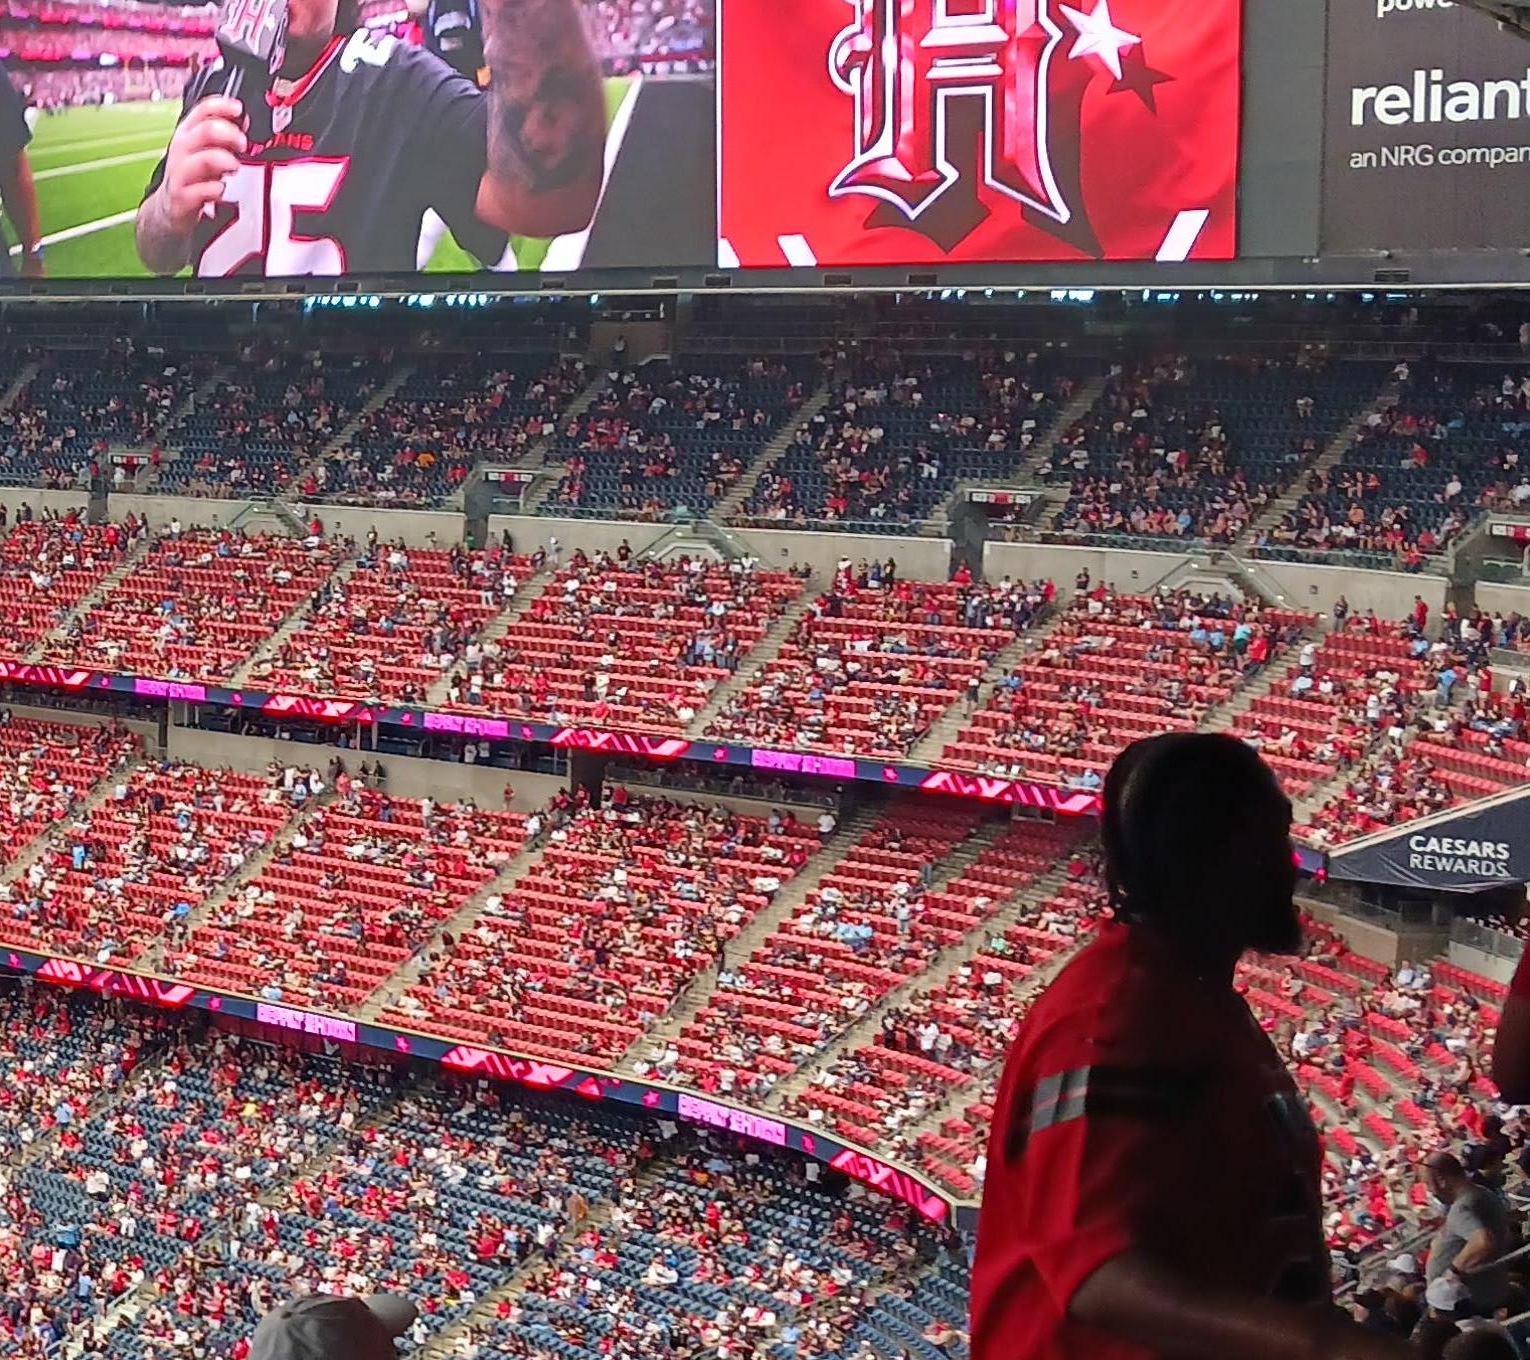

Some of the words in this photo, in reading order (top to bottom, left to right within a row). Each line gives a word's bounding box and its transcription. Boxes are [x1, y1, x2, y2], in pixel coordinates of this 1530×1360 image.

[1350, 68, 1530, 126] reliant
[1349, 151, 1377, 168] an
[1381, 144, 1435, 167] NRG
[1409, 835, 1511, 860] CAESARS
[1410, 853, 1511, 877] REWARDS
